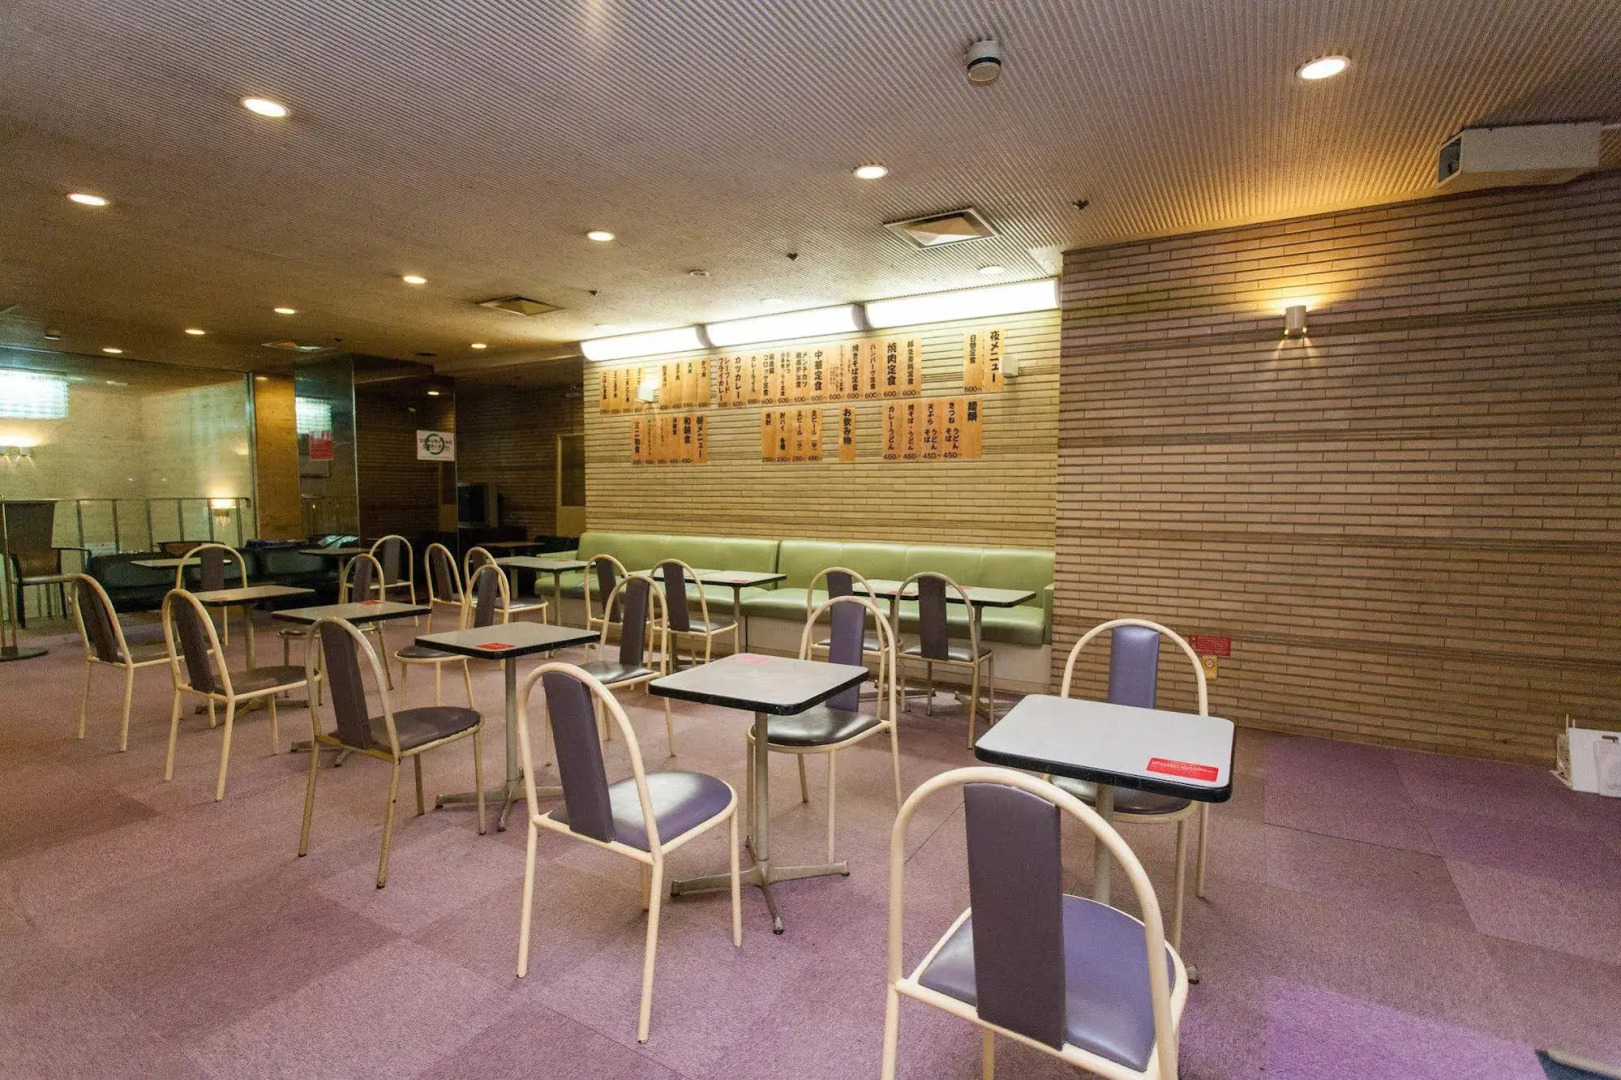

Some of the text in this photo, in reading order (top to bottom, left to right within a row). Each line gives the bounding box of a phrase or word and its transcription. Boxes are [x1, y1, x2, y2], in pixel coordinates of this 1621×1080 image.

[814, 351, 823, 391] 中華定食
[887, 342, 897, 386] 焼肉定食
[990, 331, 999, 382] 夜メニュー
[843, 408, 851, 445] お飲み物
[924, 429, 930, 443] そば
[945, 428, 952, 442] そば
